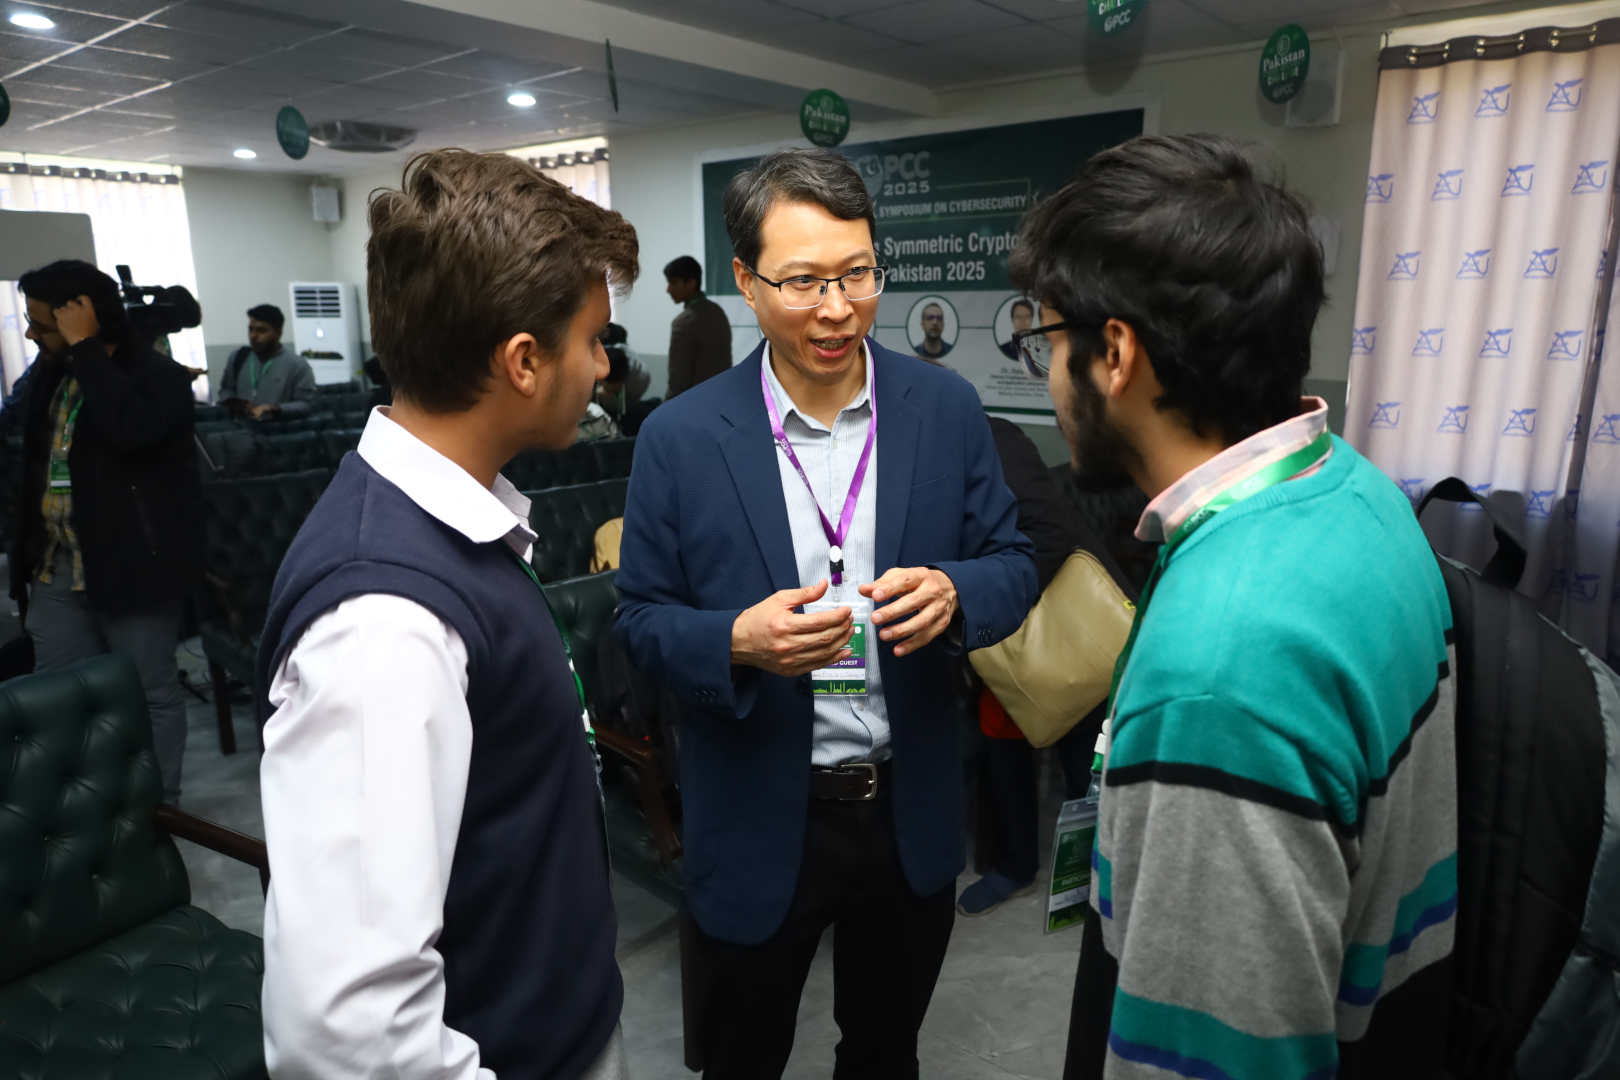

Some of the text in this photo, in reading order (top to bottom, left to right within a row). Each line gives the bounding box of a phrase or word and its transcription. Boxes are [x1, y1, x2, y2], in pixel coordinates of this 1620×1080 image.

[884, 180, 931, 196] 2025
[879, 194, 1027, 218] SYMPOSIUM ON CYBERSECURITY
[884, 234, 963, 260] Symmetric
[968, 231, 1022, 256] Crypto
[947, 261, 985, 281] 2025
